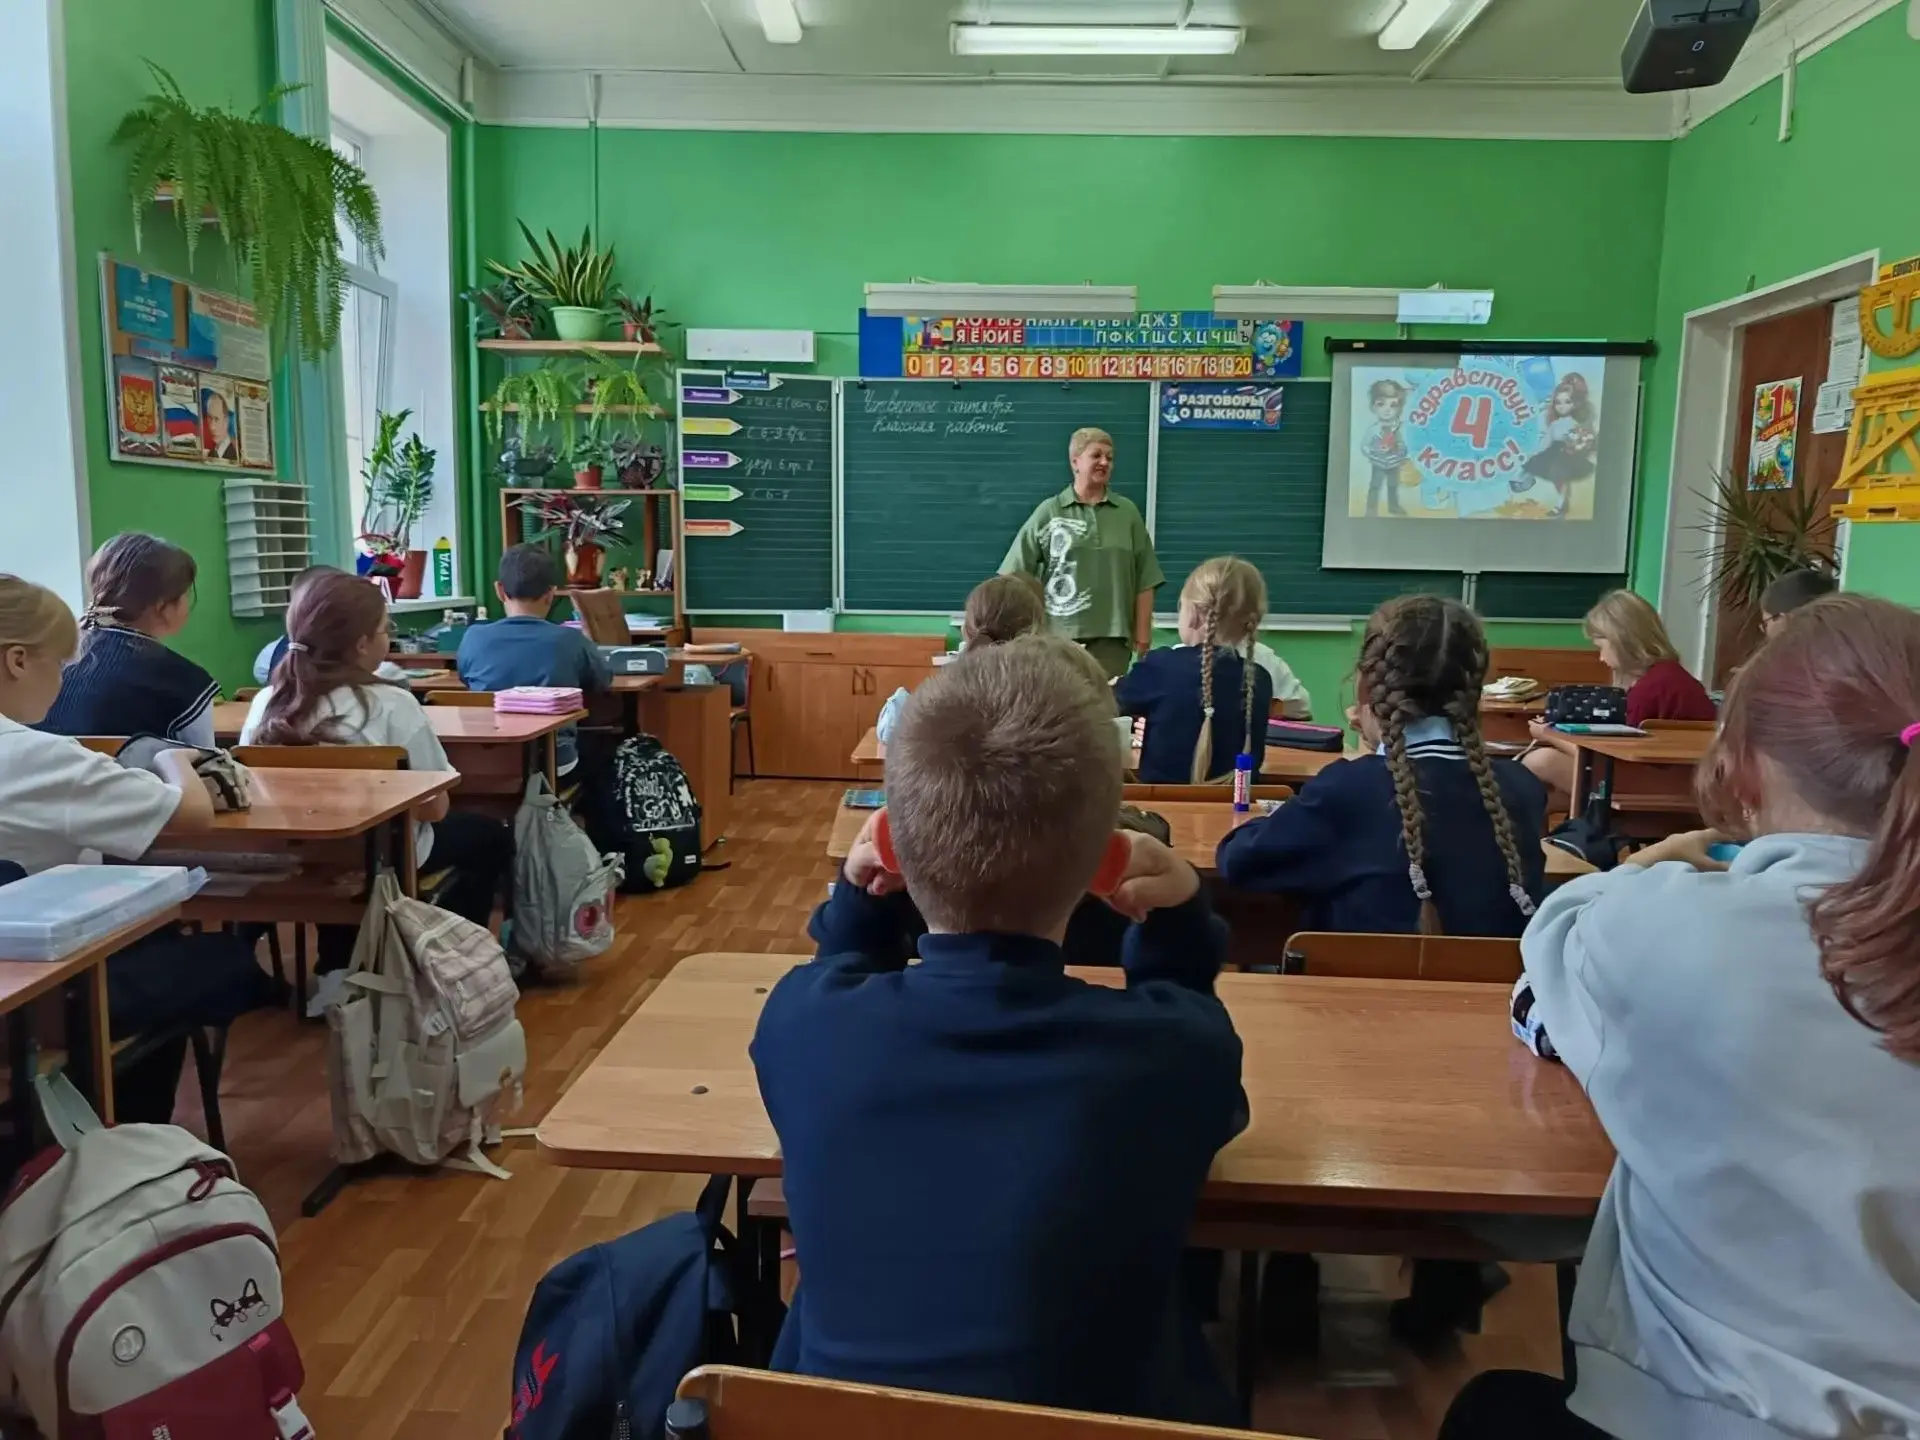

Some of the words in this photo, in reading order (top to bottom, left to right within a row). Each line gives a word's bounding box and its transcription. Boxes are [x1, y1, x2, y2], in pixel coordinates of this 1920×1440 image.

[908, 357, 920, 375] 0
[925, 357, 934, 375] 1
[940, 357, 953, 375] 2
[957, 357, 969, 375] 3
[971, 357, 985, 375] 4
[991, 357, 1002, 375] 5
[1006, 357, 1019, 375] 6
[1023, 357, 1035, 375] 7
[1040, 357, 1053, 375] 8
[1055, 357, 1067, 375] 9
[1069, 357, 1085, 375] 10
[1087, 357, 1100, 375] 11
[1102, 357, 1118, 375] 12
[1120, 357, 1135, 375] 13
[1136, 357, 1152, 375] 14
[1153, 357, 1169, 375] 15
[1169, 357, 1184, 375] 16
[1185, 357, 1201, 375] 17
[1201, 357, 1217, 375] 18
[1218, 357, 1235, 375] 19
[1235, 357, 1251, 375] 20
[1178, 394, 1266, 407] РАЗГОВОРЫ
[1409, 367, 1536, 426] Здравствуй,
[1180, 407, 1191, 419] О
[1193, 408, 1262, 421] ВАЖНОМ!
[1450, 396, 1492, 448] 4
[1418, 439, 1527, 481] класс!
[438, 553, 450, 581] ТРУД
